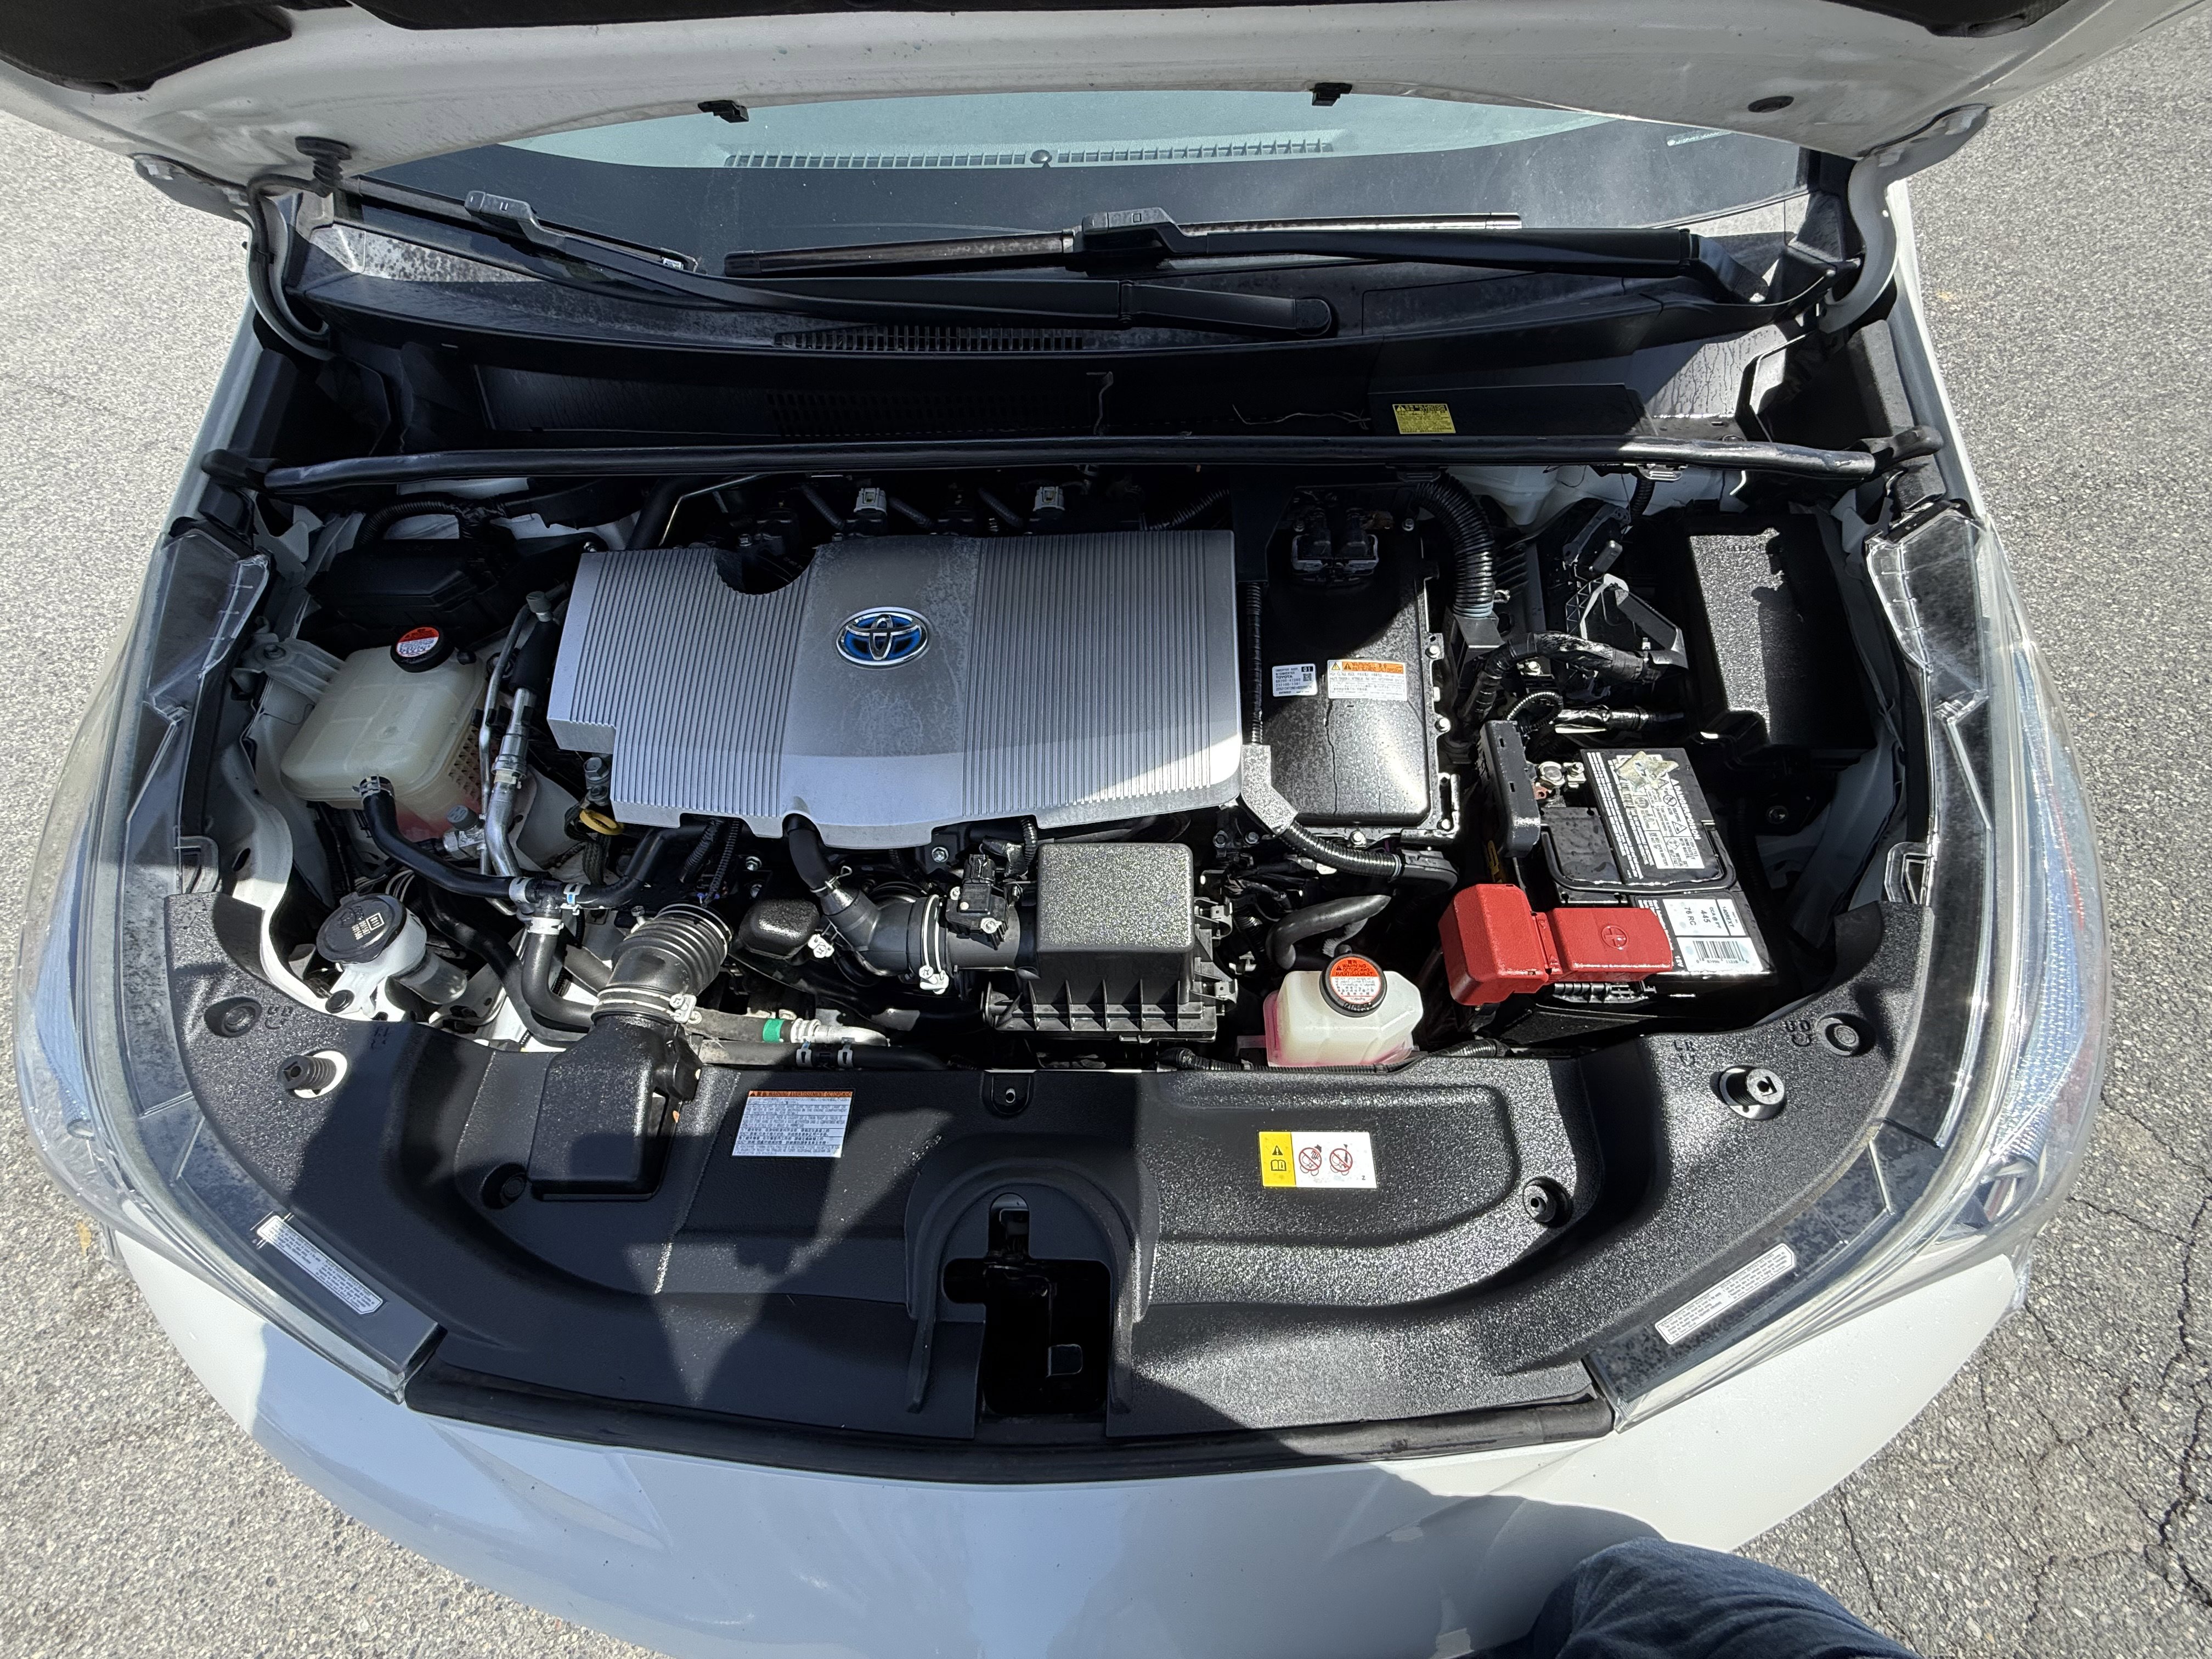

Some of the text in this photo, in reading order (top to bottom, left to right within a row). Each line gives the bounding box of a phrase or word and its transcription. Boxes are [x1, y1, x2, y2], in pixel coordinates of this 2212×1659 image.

[1674, 785, 1701, 840] DANGER/POISON
[1688, 916, 1696, 926] RC
[1701, 910, 1711, 923] 445
